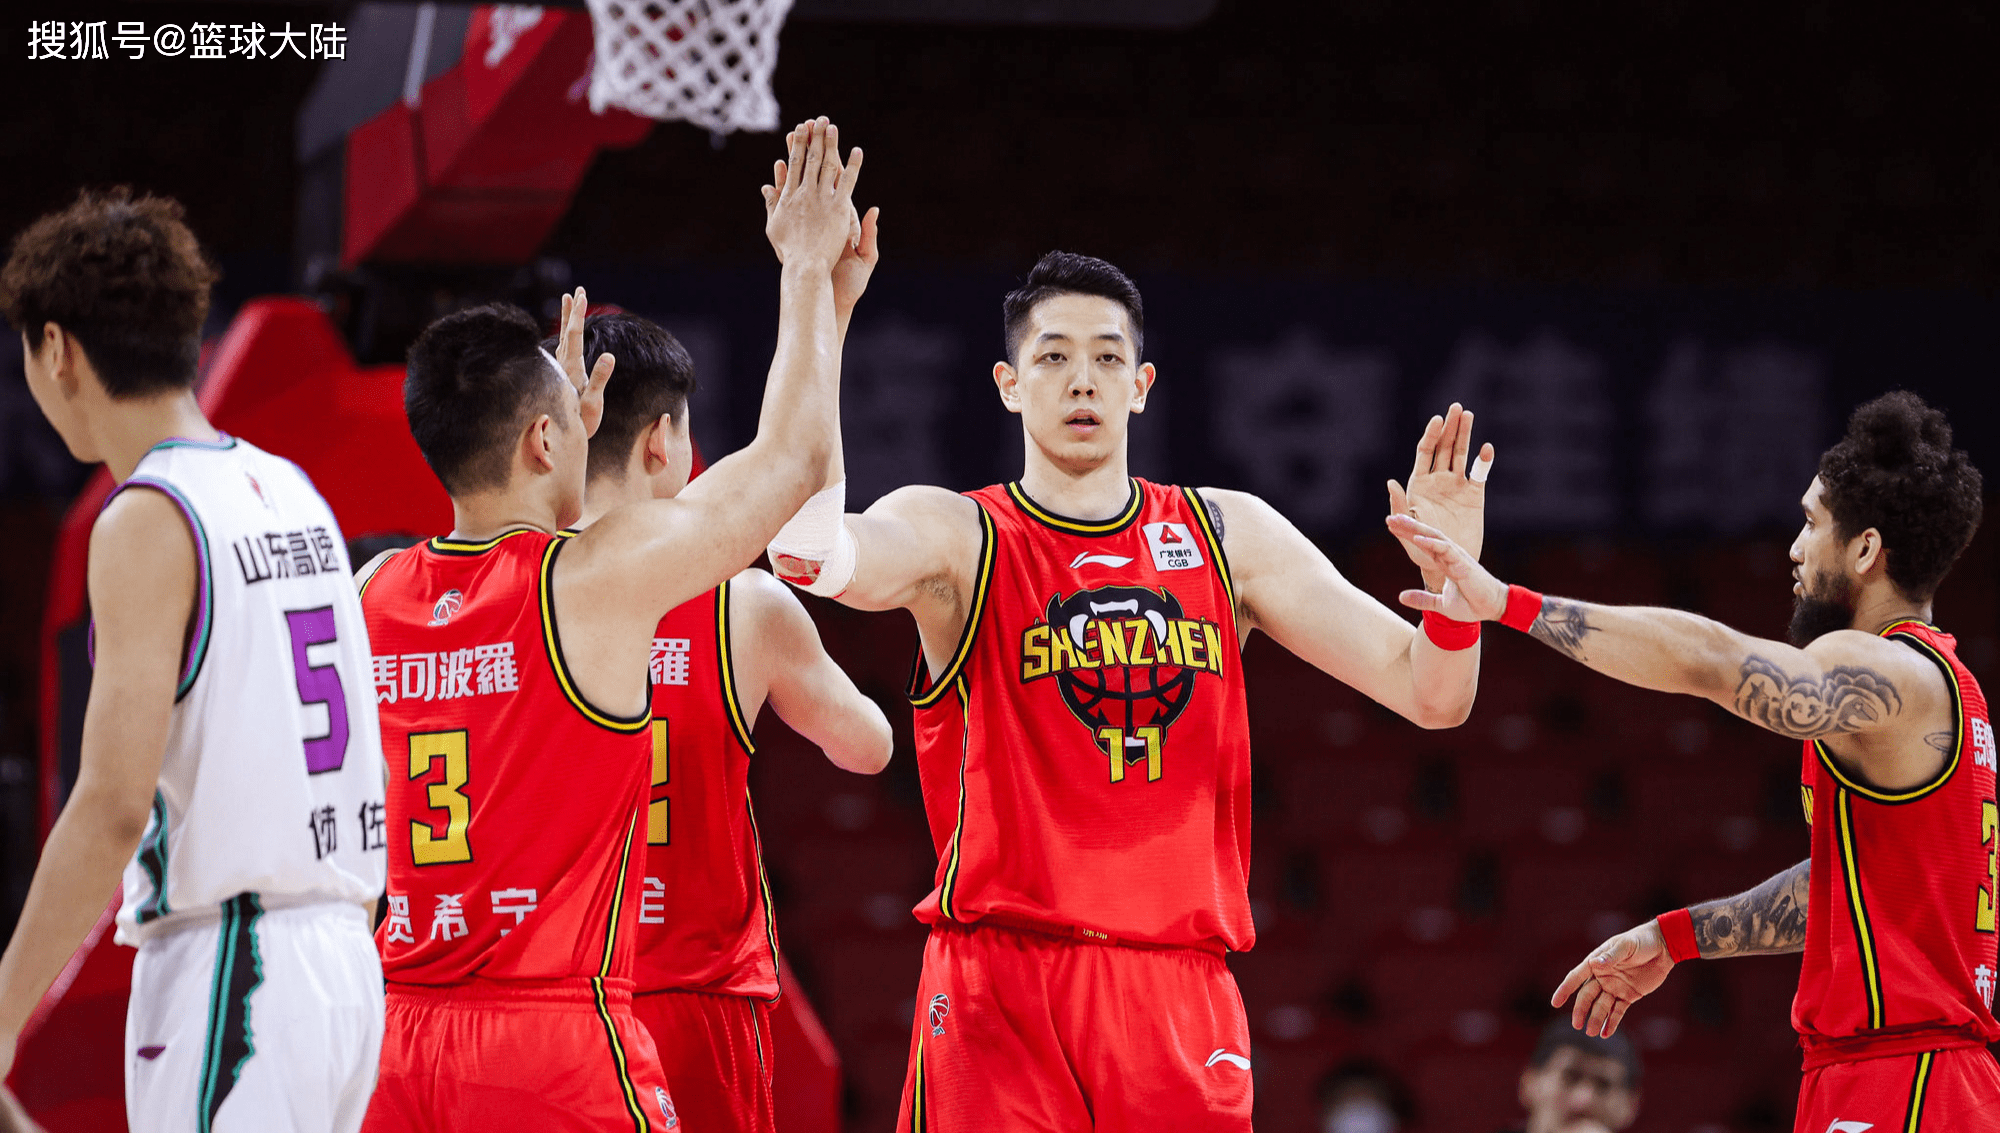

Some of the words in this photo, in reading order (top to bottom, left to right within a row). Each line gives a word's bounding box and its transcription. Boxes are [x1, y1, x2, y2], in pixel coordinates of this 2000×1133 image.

[233, 526, 340, 585] 山东高速
[1167, 559, 1189, 568] CGB
[371, 641, 520, 704] 馬可波羅
[1020, 616, 1224, 684] SHENZHEN
[284, 605, 350, 776] 5
[1097, 724, 1163, 784] 11
[407, 728, 474, 867] 3
[387, 887, 538, 944] 贺希宁
